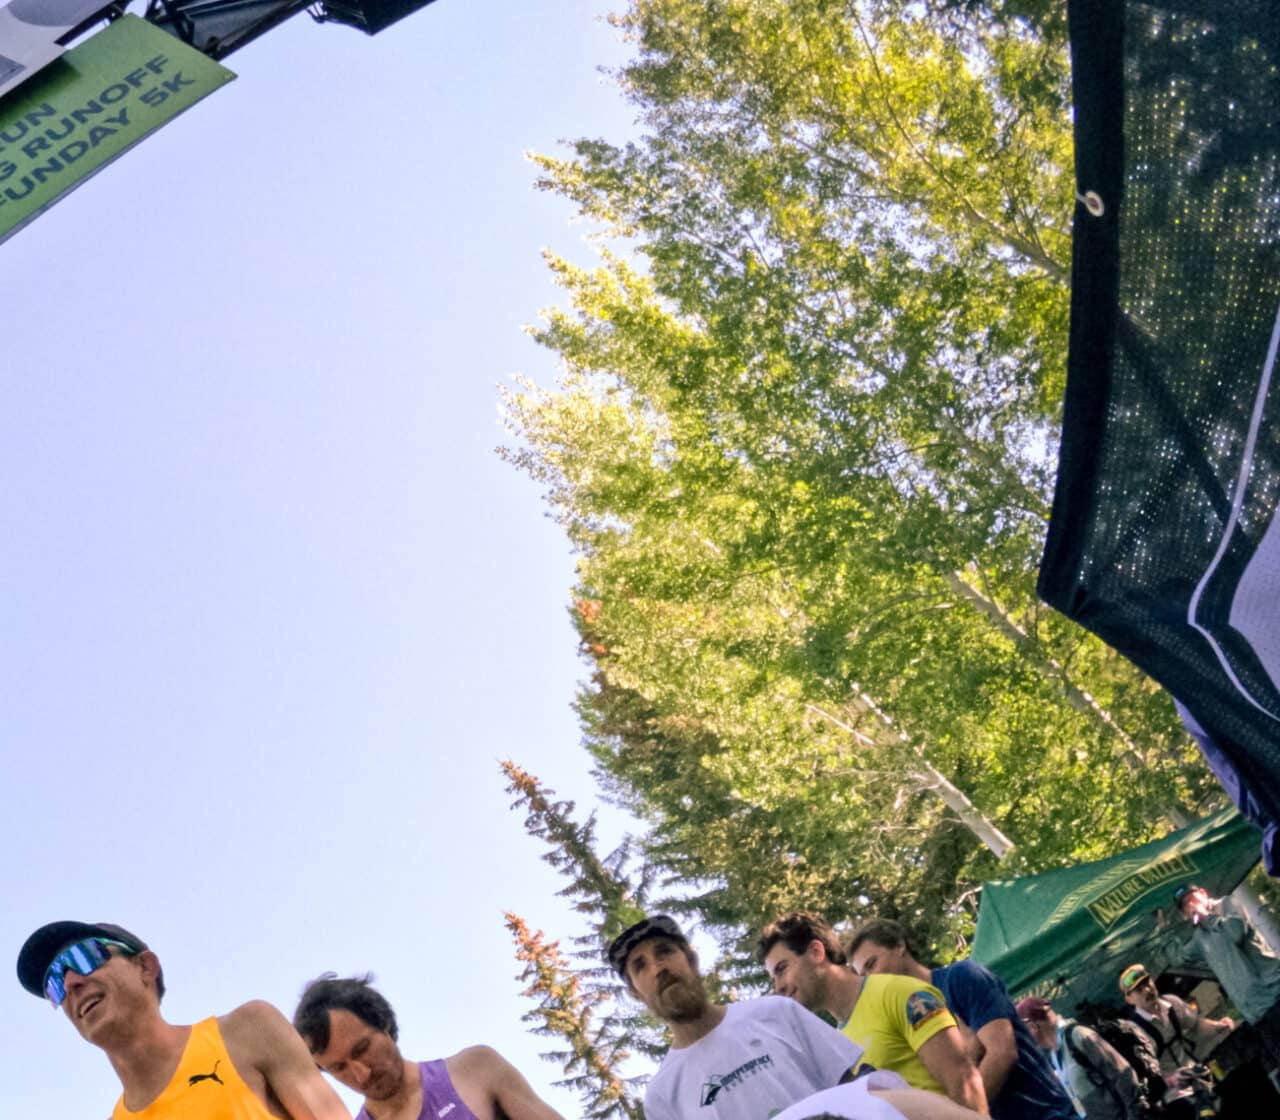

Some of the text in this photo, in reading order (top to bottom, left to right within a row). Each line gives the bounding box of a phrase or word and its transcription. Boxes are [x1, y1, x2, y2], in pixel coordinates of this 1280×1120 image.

[22, 54, 170, 160] RUNOFF
[139, 71, 196, 107] 5K
[1092, 880, 1141, 925] NATURE
[1138, 855, 1190, 885] VALLEY
